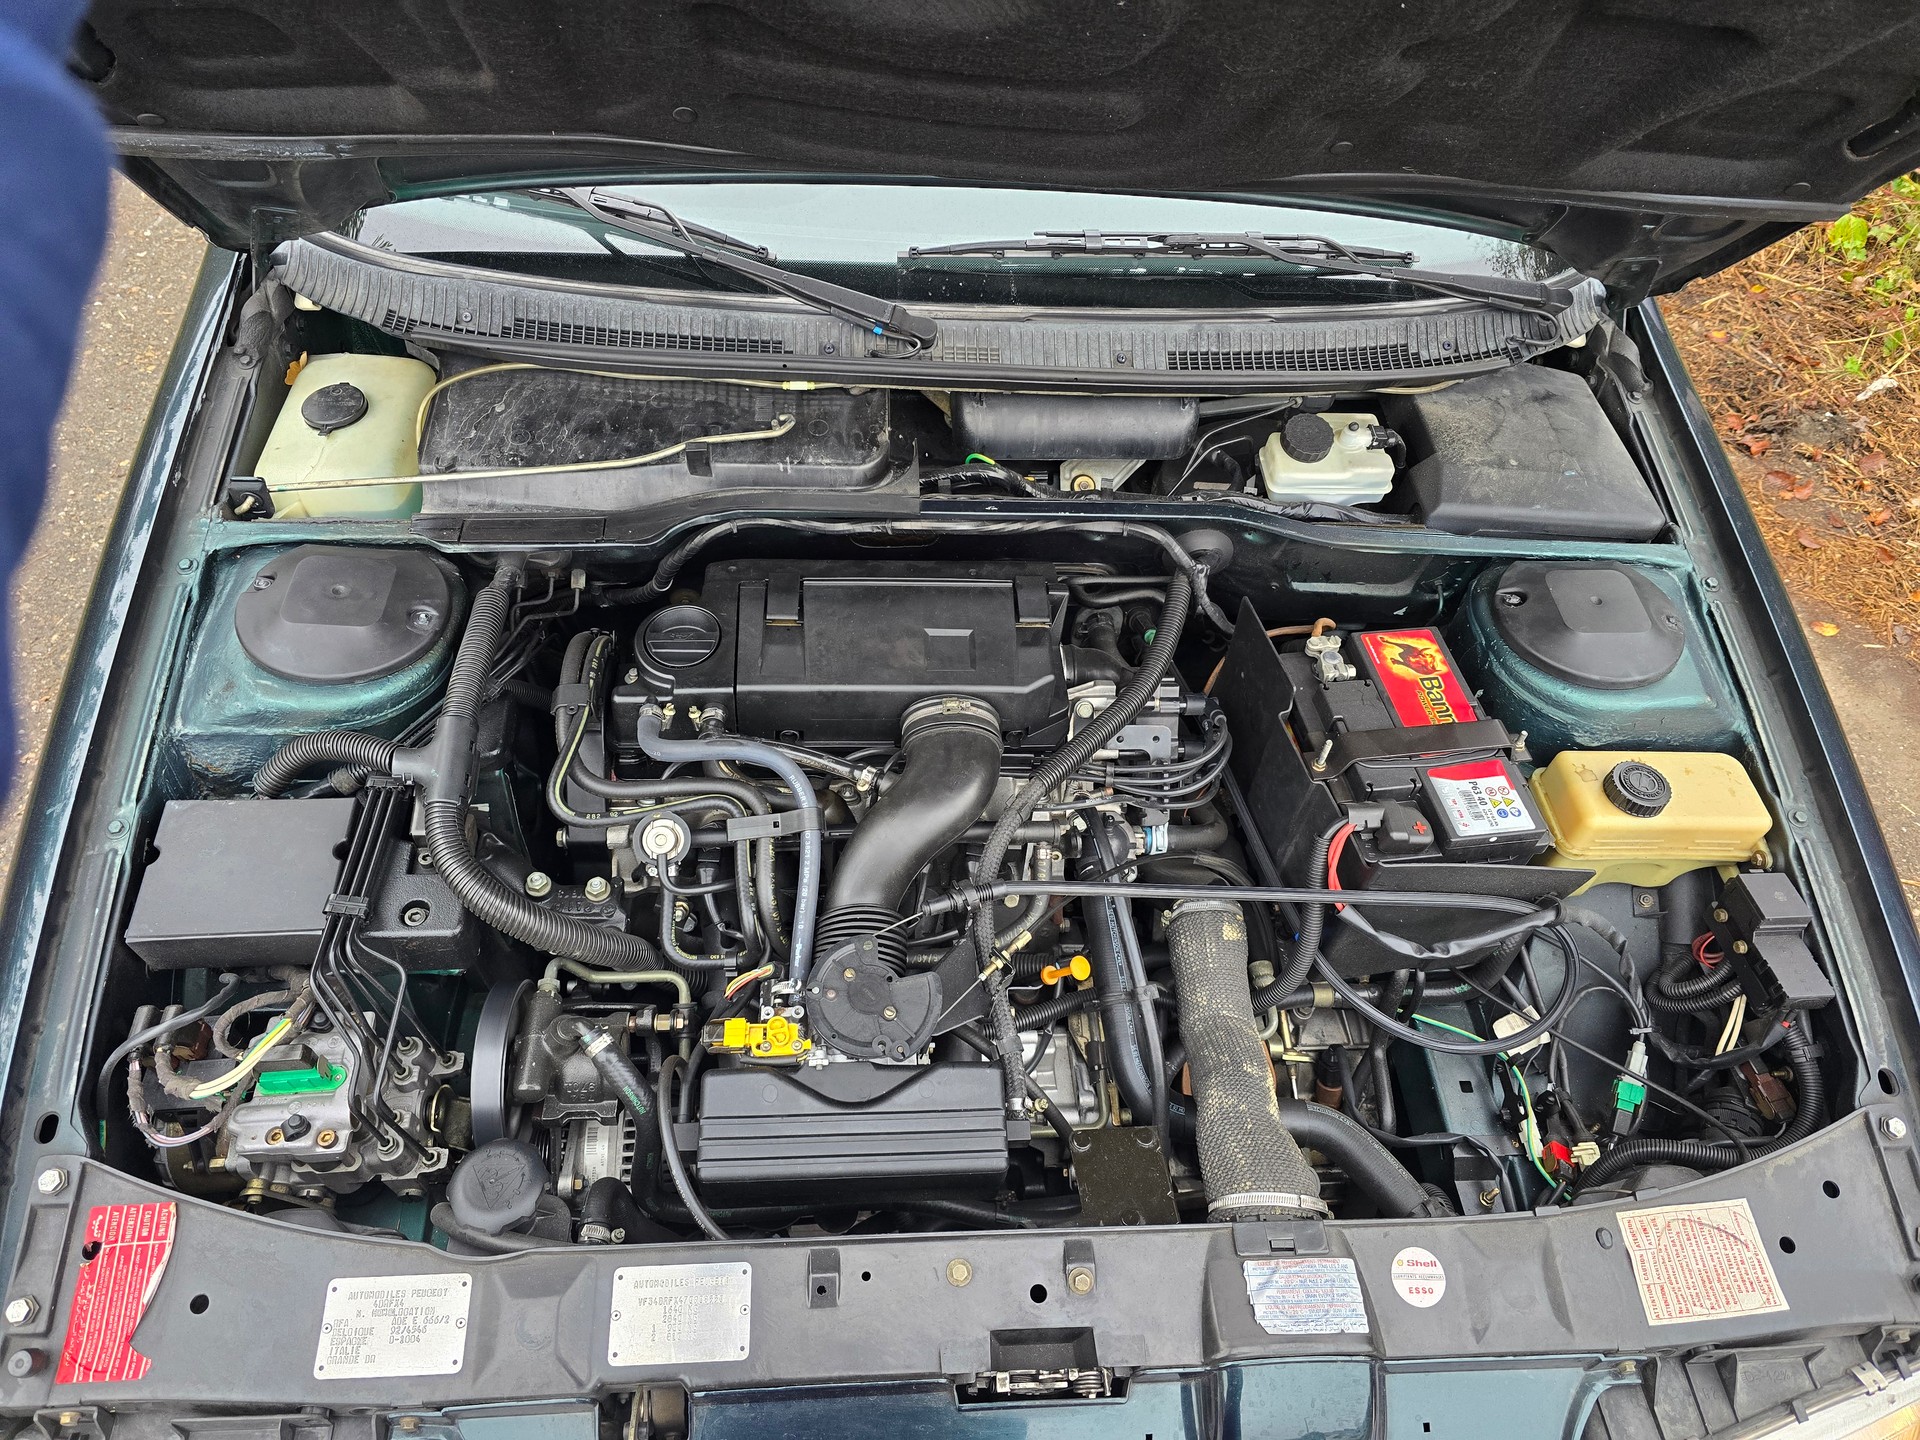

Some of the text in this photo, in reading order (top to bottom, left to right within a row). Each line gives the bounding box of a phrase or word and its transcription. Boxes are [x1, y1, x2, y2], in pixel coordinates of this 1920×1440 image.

[1416, 690, 1432, 716] POWER
[788, 774, 806, 799] RUBBER
[1468, 781, 1488, 806] P63 40
[107, 1211, 120, 1240] ATENCION
[123, 1207, 137, 1242] ATTENZIONE
[140, 1210, 152, 1236] CAUTION
[156, 1208, 169, 1236] ACHTUNG
[1626, 1219, 1641, 1248] ATENCION
[1638, 1219, 1652, 1245] ATTENTIE
[1636, 1253, 1650, 1280] CAUTION
[1648, 1250, 1663, 1280] ACHTUNG
[1668, 1264, 1679, 1284] moteur
[1677, 1259, 1691, 1290] disconnect
[1684, 1260, 1694, 1279] engine
[1715, 1256, 1726, 1276] motore
[1723, 1252, 1739, 1282] BATTERIE
[348, 1288, 448, 1300] AUTOMOBILES PEUGEOT
[634, 1279, 689, 1289] AUTOMOBILES
[1645, 1284, 1660, 1318] ATTENTION
[1658, 1284, 1673, 1316] ATTENZIONE
[326, 1355, 360, 1364] GRANDE
[330, 1346, 361, 1355] ITALIE
